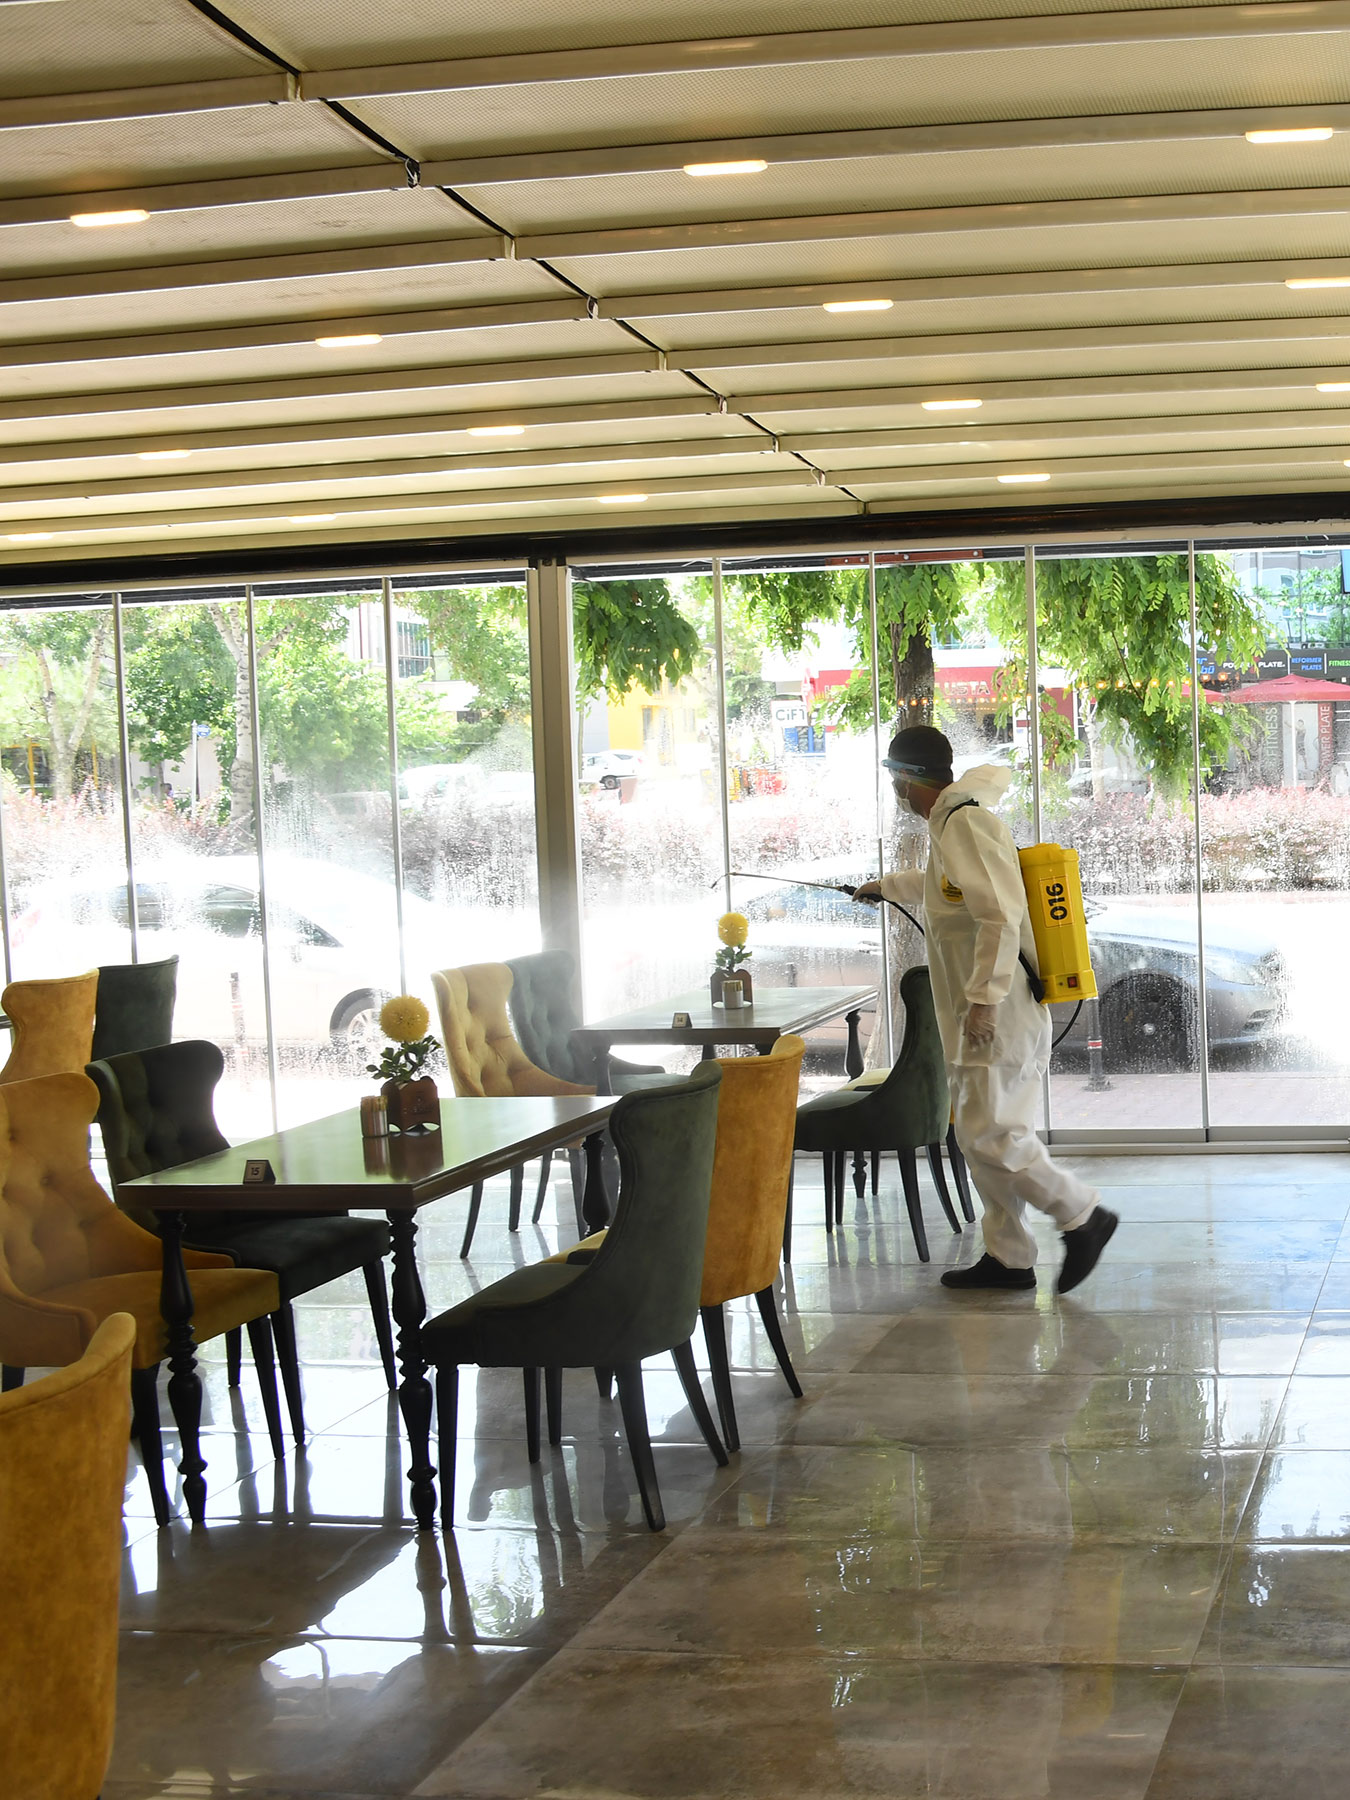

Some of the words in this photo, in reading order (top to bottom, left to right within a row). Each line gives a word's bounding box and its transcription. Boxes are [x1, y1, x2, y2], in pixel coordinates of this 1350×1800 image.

[943, 680, 991, 696] USTA
[1264, 707, 1279, 757] FITNESS
[1320, 705, 1331, 734] PLATE
[1046, 883, 1068, 920] 016
[251, 1167, 260, 1176] 15
